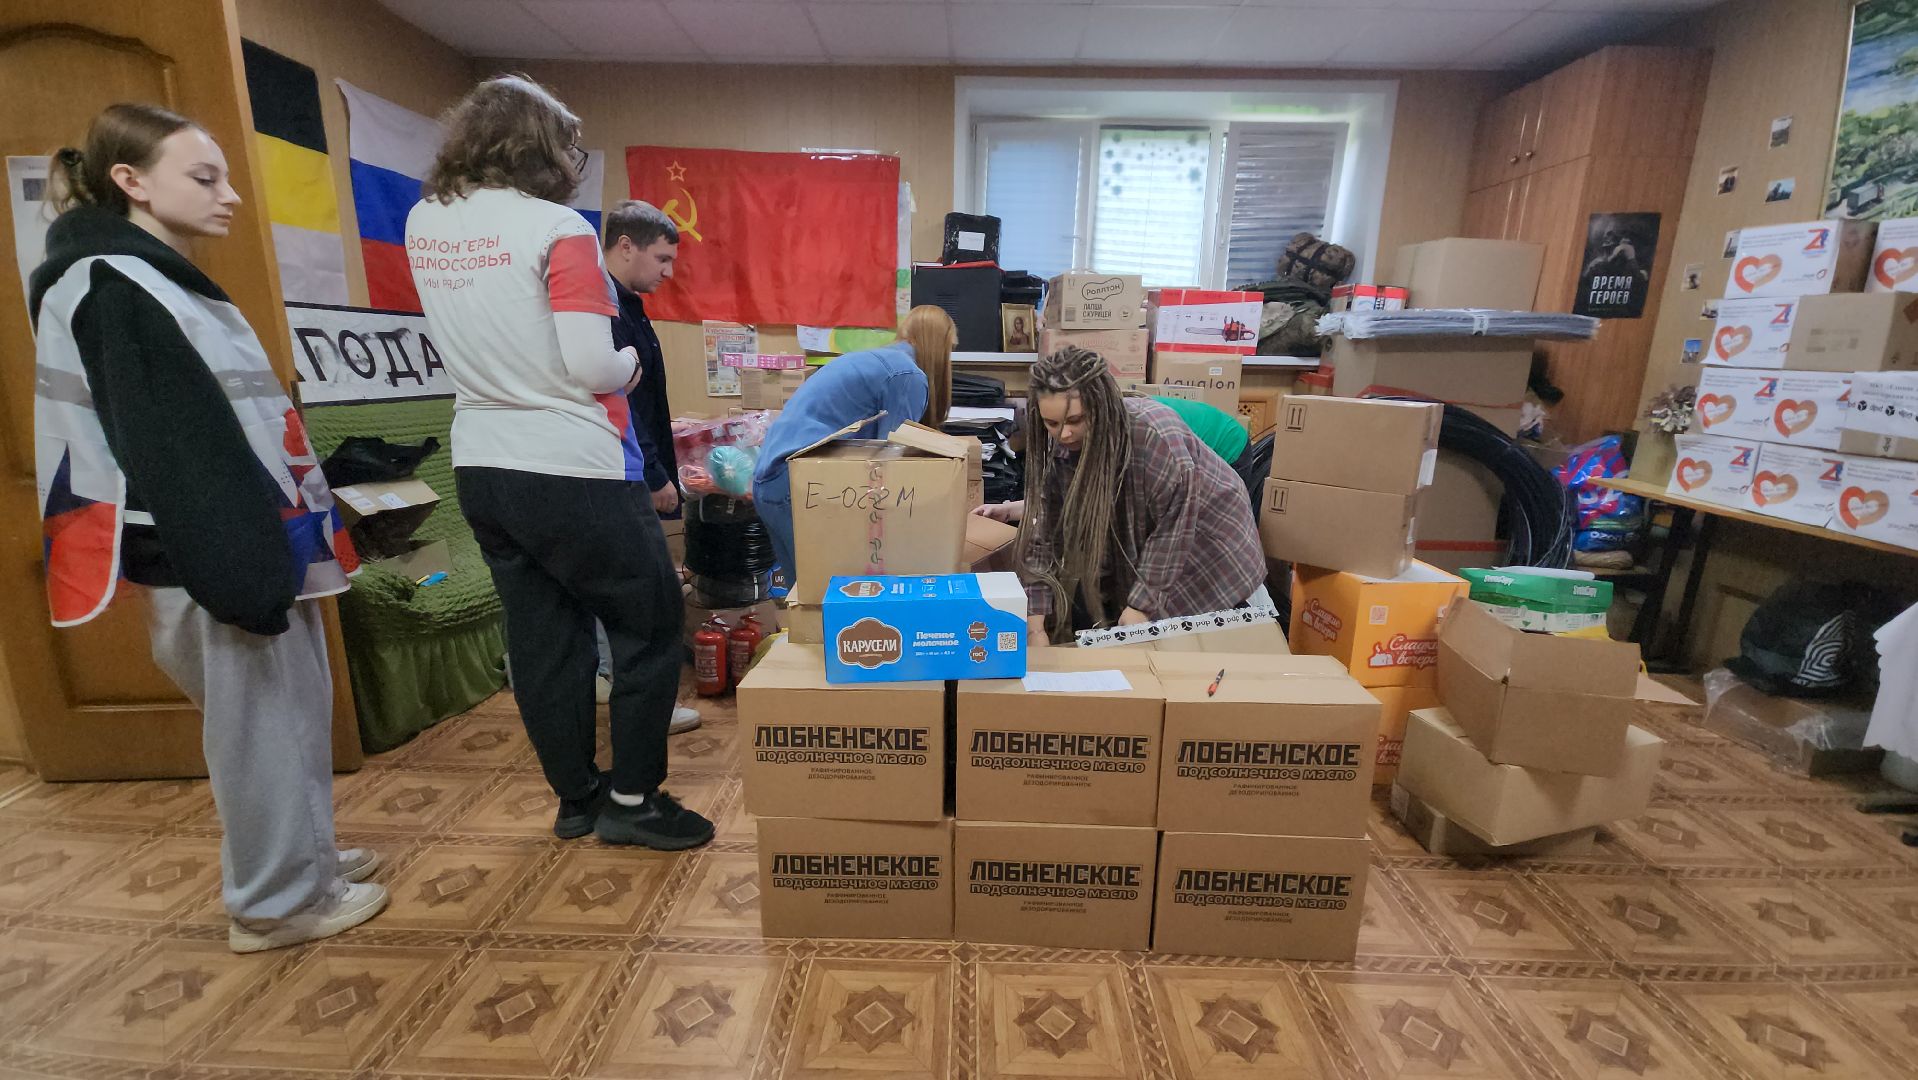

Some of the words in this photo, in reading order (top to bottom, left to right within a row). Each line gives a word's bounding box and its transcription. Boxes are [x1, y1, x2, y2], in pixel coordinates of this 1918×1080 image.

[408, 235, 499, 254] ВОЛОНЕРЫ
[1592, 275, 1633, 290] ВРЕМЯ
[1589, 290, 1630, 305] ГЕРОЕВ
[1083, 303, 1103, 311] ЛАПША
[293, 327, 448, 388] ГОДА
[912, 638, 960, 648] молочное
[916, 631, 956, 641] Печенье
[843, 638, 897, 653] КАРУСЕЛИ
[755, 726, 928, 750] ЛОБНЕНСКОЕ
[971, 731, 1148, 759] ЛОБНЕНСКОЕ
[756, 751, 873, 764] подсолнечное
[875, 753, 927, 765] масло
[1178, 741, 1361, 766] ЛОБНЕНСКОЕ
[972, 756, 1090, 770] подсолнечное
[1093, 759, 1146, 773] масло
[1178, 766, 1300, 780] подсолнечное
[1302, 769, 1356, 781] масло
[772, 855, 940, 877] ЛОБНЕНСКОЕ
[970, 861, 1140, 887] ЛОБНЕНСКОЕ
[773, 877, 887, 890] подсолнечное
[889, 879, 938, 891] масло
[1175, 870, 1352, 897] ЛОБНЕНСКОЕ
[970, 884, 1086, 898] подсолнечное
[1088, 888, 1138, 900] масло
[1175, 892, 1293, 908] подсолнечное
[1295, 897, 1347, 910] масло
